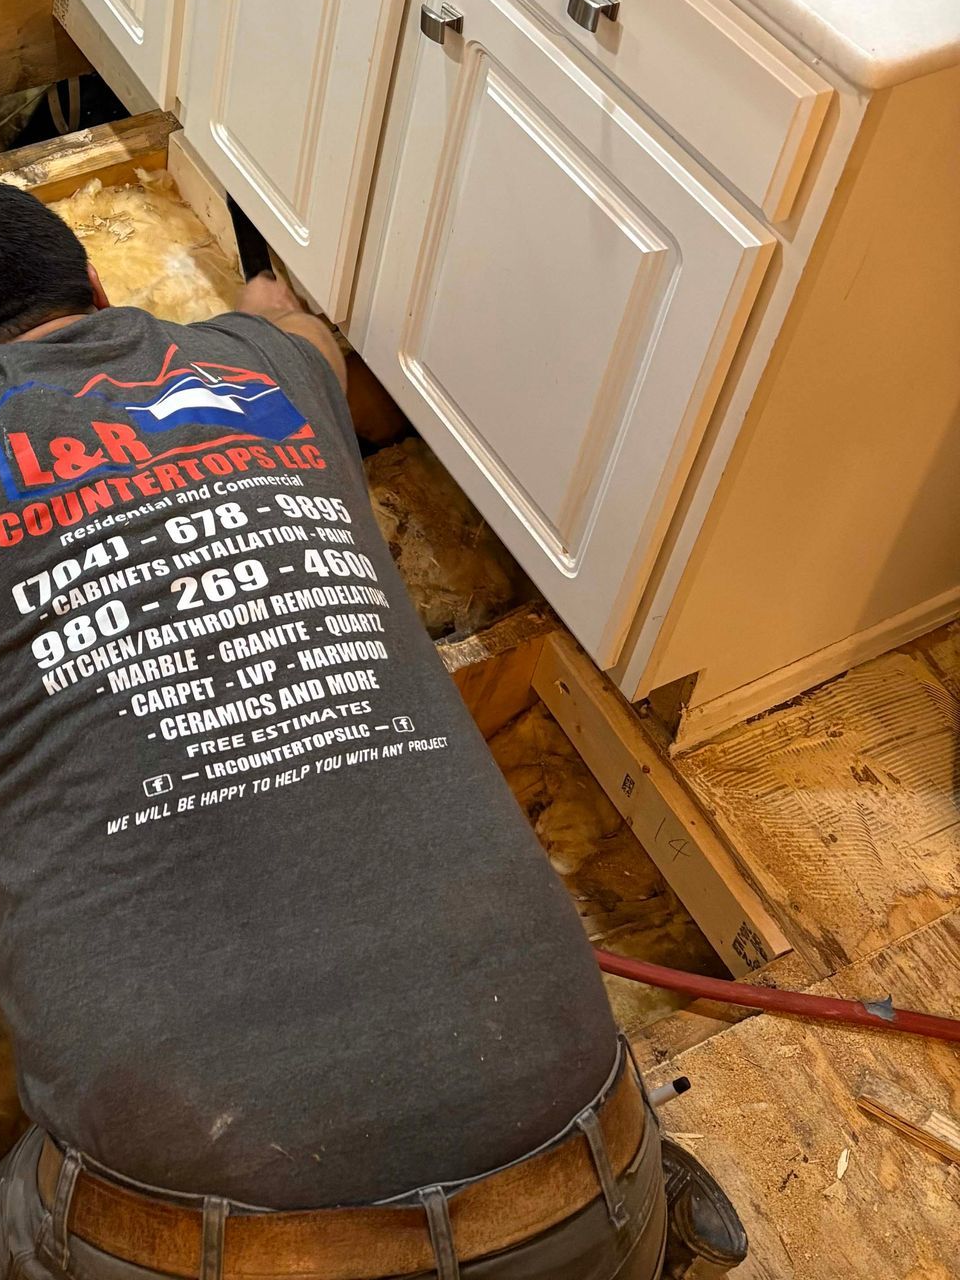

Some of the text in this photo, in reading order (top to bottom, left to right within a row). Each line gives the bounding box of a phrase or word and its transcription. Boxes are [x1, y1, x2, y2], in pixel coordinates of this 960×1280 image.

[8, 421, 153, 487] L&R
[273, 444, 327, 470] LLC
[59, 474, 305, 547] Residential and Commercial
[164, 501, 249, 545] 678
[274, 493, 352, 525] 9895
[51, 557, 171, 616] CABINETS
[171, 525, 309, 570] INTALLATION
[31, 599, 130, 669] 980
[170, 558, 269, 611] 269
[303, 548, 378, 583] 4600
[41, 585, 391, 696] KITCHEN/BATHROOM REMODELATIONS
[107, 648, 199, 694] MARBLE
[218, 620, 310, 663] GRANITE
[324, 613, 385, 637] QUARTZ
[130, 677, 216, 717] CARPET
[236, 659, 277, 690] LVP
[296, 640, 388, 671] HARWOOD
[159, 693, 277, 741] CERAMICS
[278, 678, 325, 710] AND
[325, 669, 380, 696] MORE
[186, 700, 372, 758] FREE ESTIMATES
[106, 736, 448, 835] WE WILL BE HAPPY TO HELP YOU WITH ANY PROJECT
[204, 723, 371, 780] LRCOUNTERTOPSLLC
